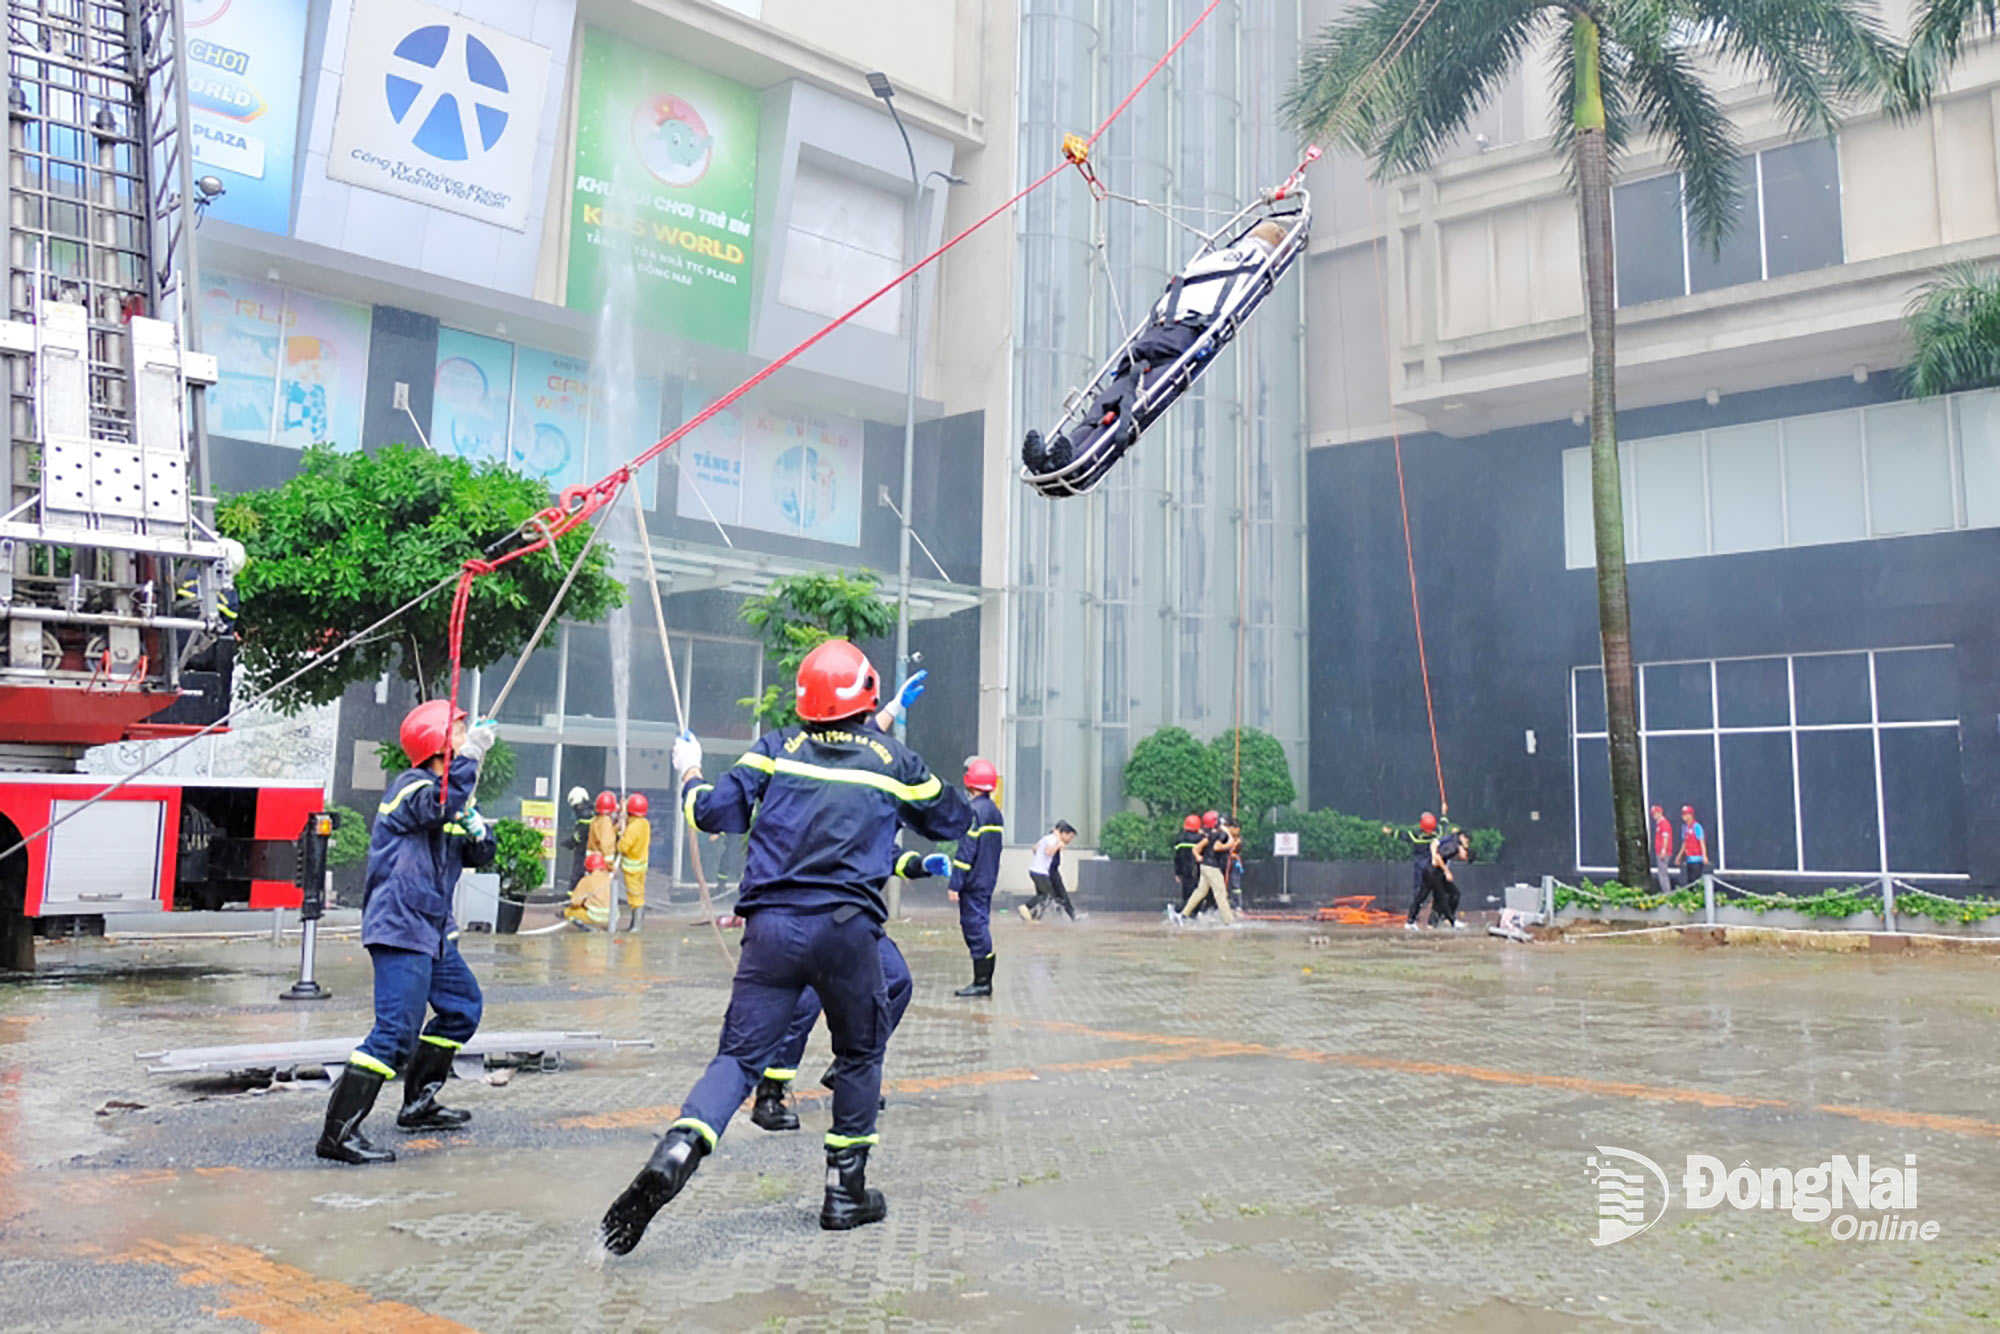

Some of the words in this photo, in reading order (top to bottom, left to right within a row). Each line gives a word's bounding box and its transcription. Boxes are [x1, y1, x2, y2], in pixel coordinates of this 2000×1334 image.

[188, 77, 252, 107] ORLD
[192, 123, 247, 150] PLAZA
[728, 217, 751, 237] EM
[652, 221, 744, 264] WORLD
[686, 261, 704, 275] TTC
[706, 268, 737, 285] PLAZA
